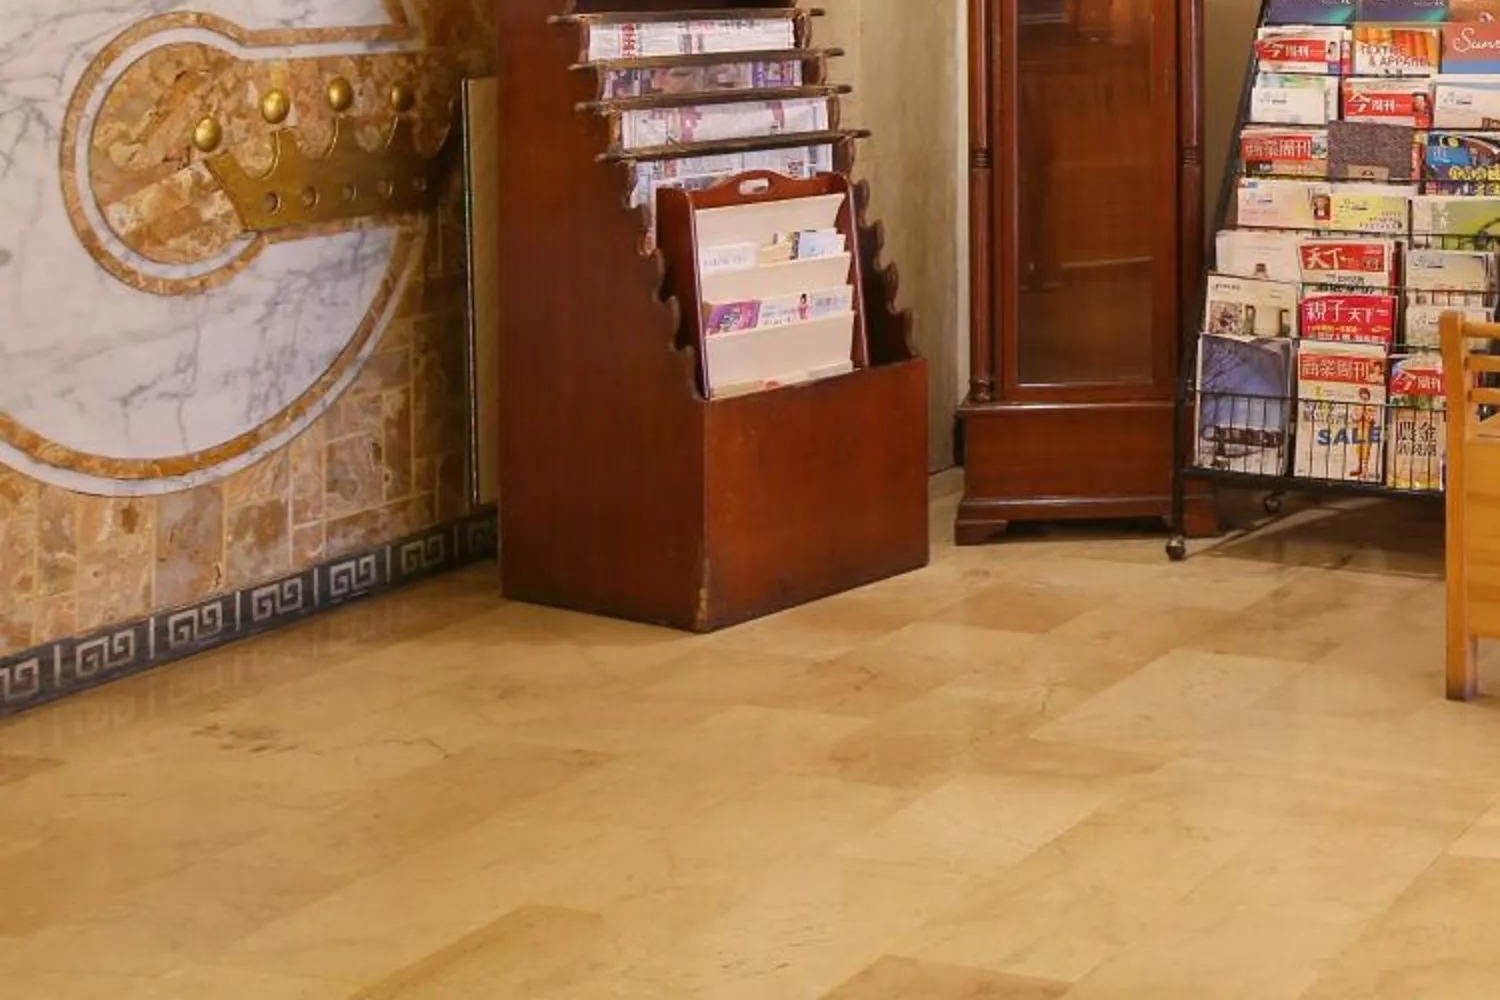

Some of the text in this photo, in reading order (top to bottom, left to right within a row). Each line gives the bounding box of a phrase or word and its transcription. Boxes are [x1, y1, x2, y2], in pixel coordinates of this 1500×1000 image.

[1307, 246, 1343, 269] 天下
[1305, 300, 1375, 323] 親子天下
[1317, 427, 1383, 446] SALE
